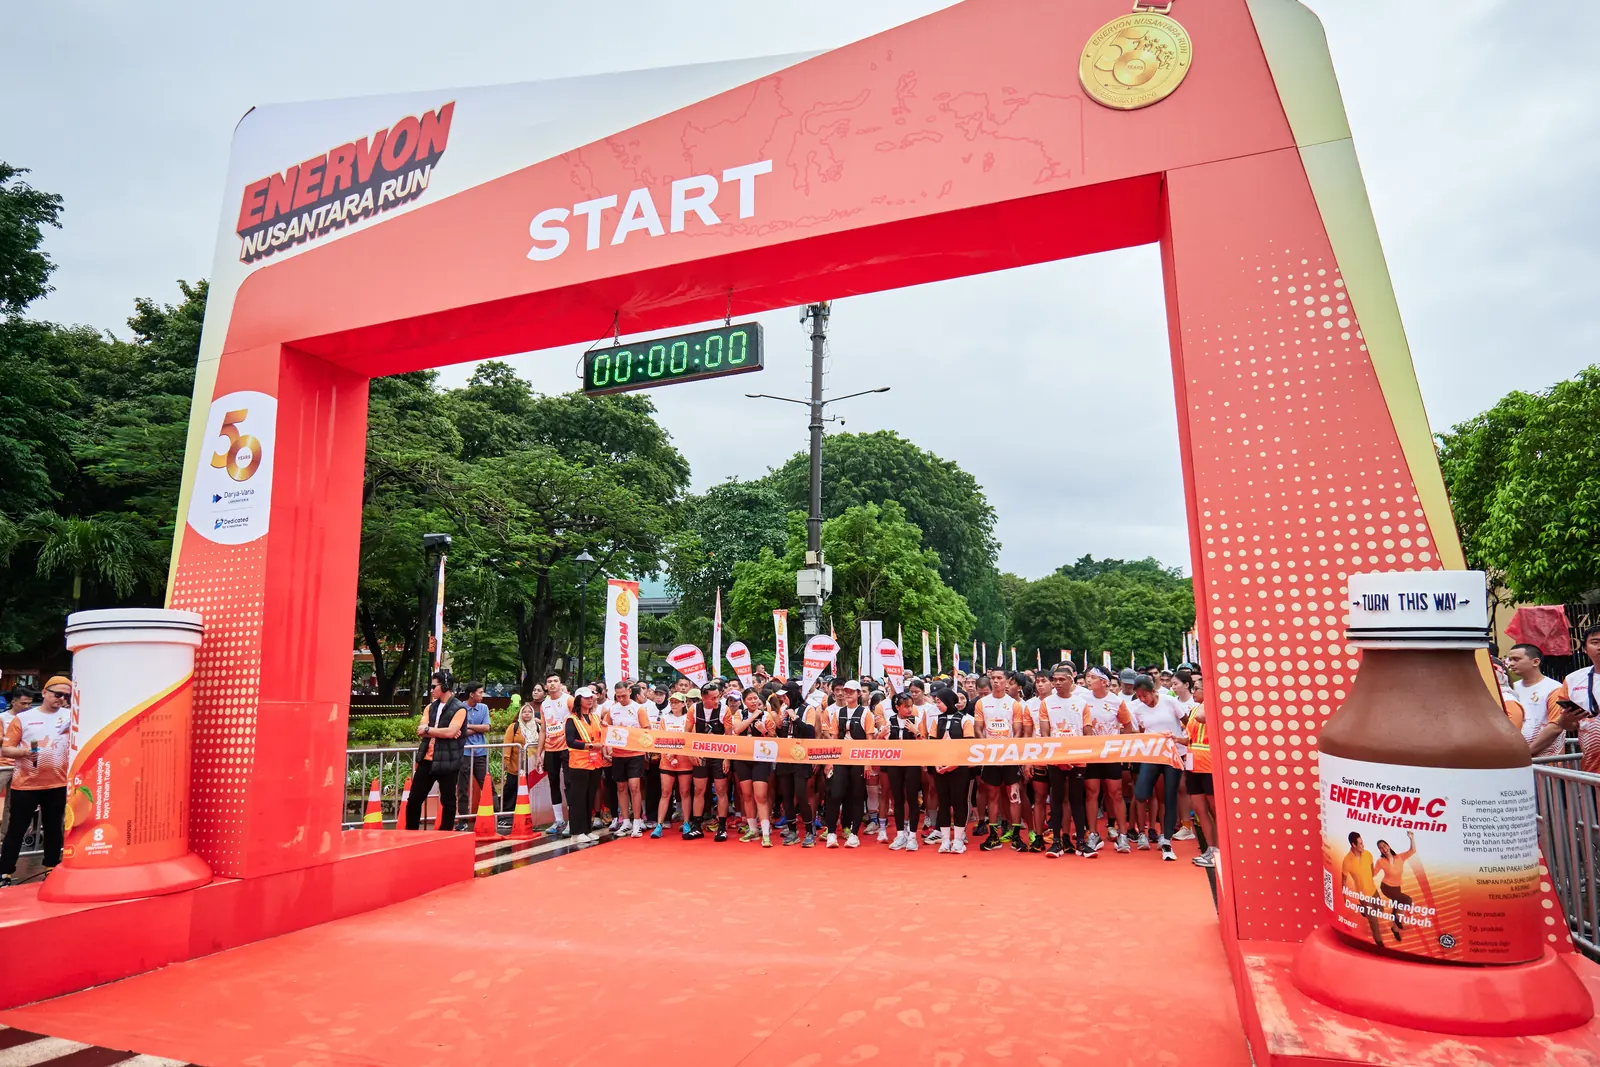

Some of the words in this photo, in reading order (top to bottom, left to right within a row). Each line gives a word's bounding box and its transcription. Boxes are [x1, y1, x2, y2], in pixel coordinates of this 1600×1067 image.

[1092, 19, 1132, 46] ENERVON
[1134, 18, 1181, 39] NUSANTARA
[1179, 37, 1188, 54] RUN
[236, 101, 455, 232] ENERVON
[240, 187, 374, 259] NUSANTARA
[377, 164, 431, 206] RUN
[526, 159, 773, 261] START
[593, 331, 747, 386] 00:00:00
[224, 488, 255, 499] Darya-Varia
[224, 517, 249, 525] Dedicated
[1362, 594, 1389, 611] TURN
[1398, 593, 1428, 610] THIS
[1433, 593, 1457, 610] WAY
[693, 741, 737, 754] ENERVON
[808, 747, 842, 755] ENERVON
[851, 750, 901, 760] ENERVON
[967, 742, 1062, 763] START
[96, 757, 104, 785] Menjaga
[1341, 776, 1375, 789] Suplemen
[1376, 782, 1421, 794] Kesehatan
[95, 785, 103, 820] Membantu
[102, 802, 111, 819] Daya
[1329, 783, 1447, 818] ENERVON-C
[1461, 798, 1496, 806] Suplemen
[1346, 807, 1448, 833] Multivitamin
[93, 828, 104, 841] 8
[1463, 831, 1482, 839] yang
[1484, 831, 1519, 839] kekurangan
[1342, 886, 1387, 907] Membantu
[1387, 898, 1436, 917] Menjaga
[1345, 899, 1366, 914] Daya
[1366, 906, 1396, 921] Tahan
[1397, 913, 1432, 928] Tubuh
